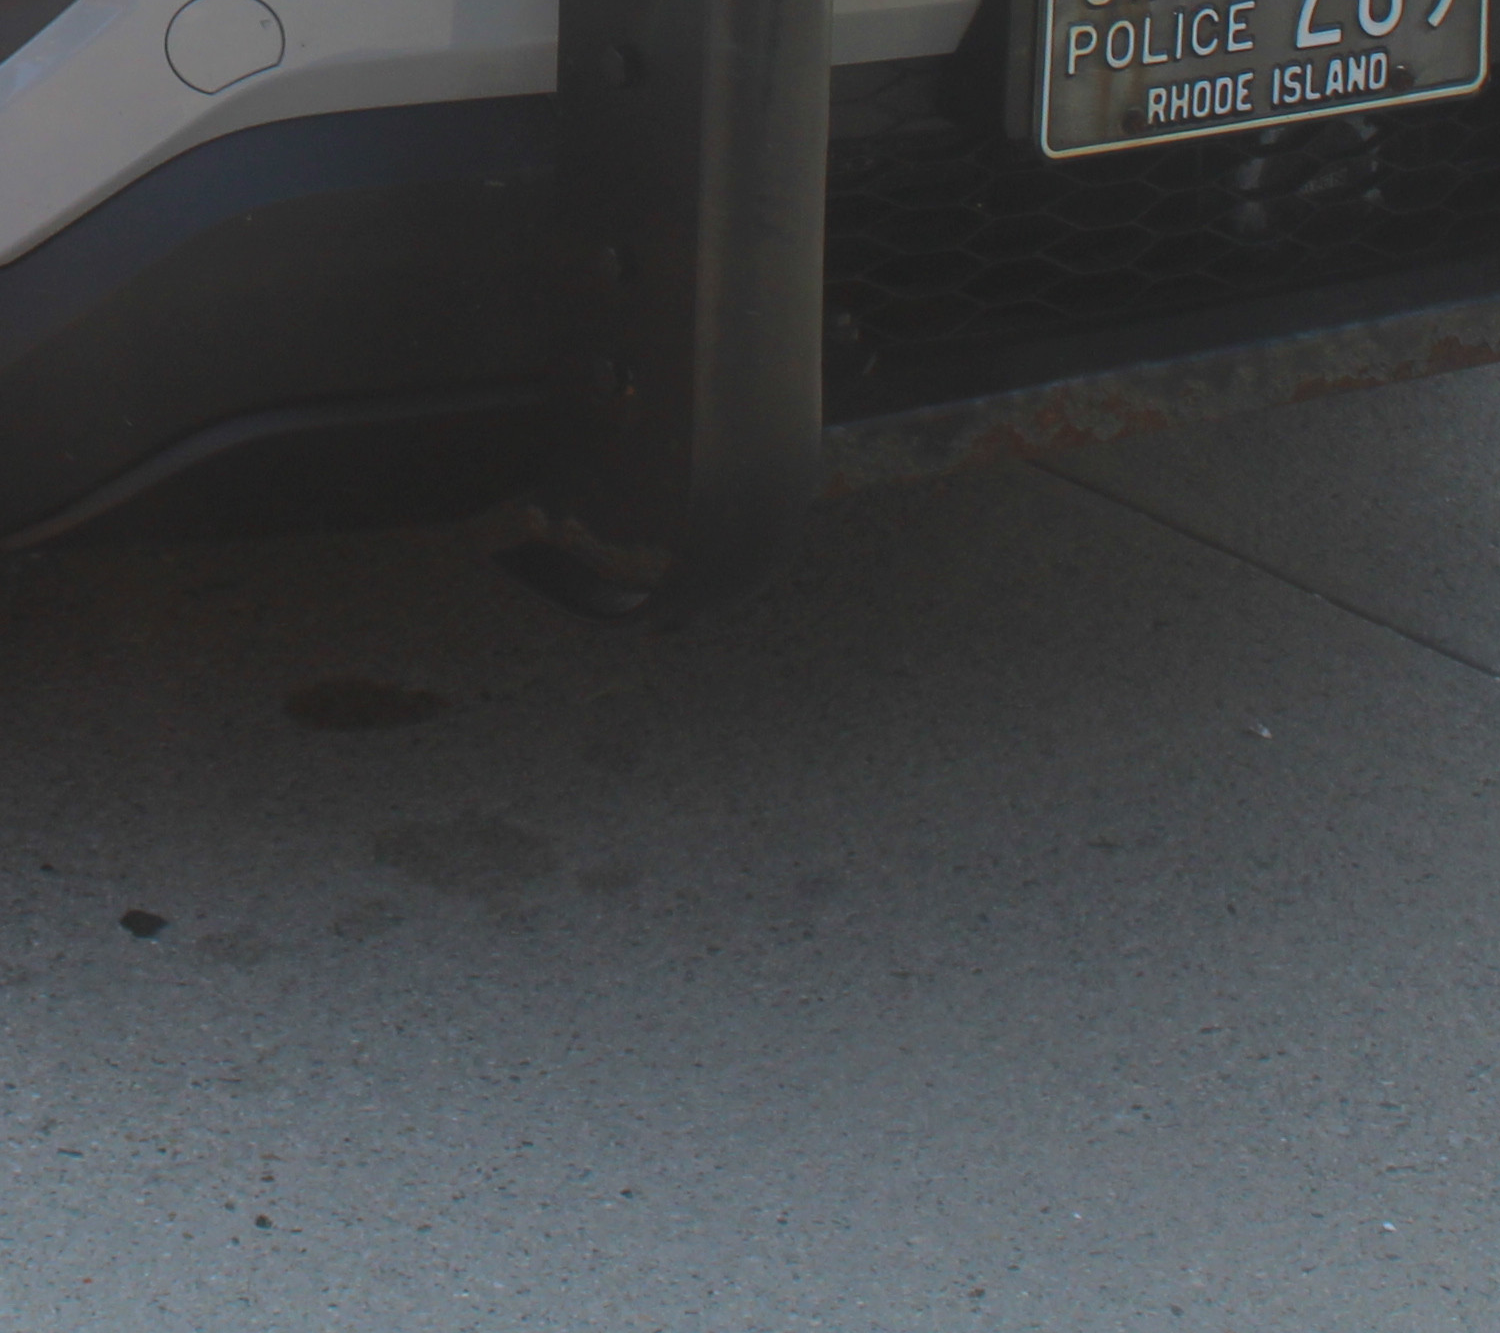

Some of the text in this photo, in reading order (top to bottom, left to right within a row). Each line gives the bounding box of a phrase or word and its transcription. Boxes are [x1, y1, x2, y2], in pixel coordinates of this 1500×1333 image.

[1067, 0, 1257, 76] POLICE
[1146, 52, 1389, 125] RHODE ISLAND
